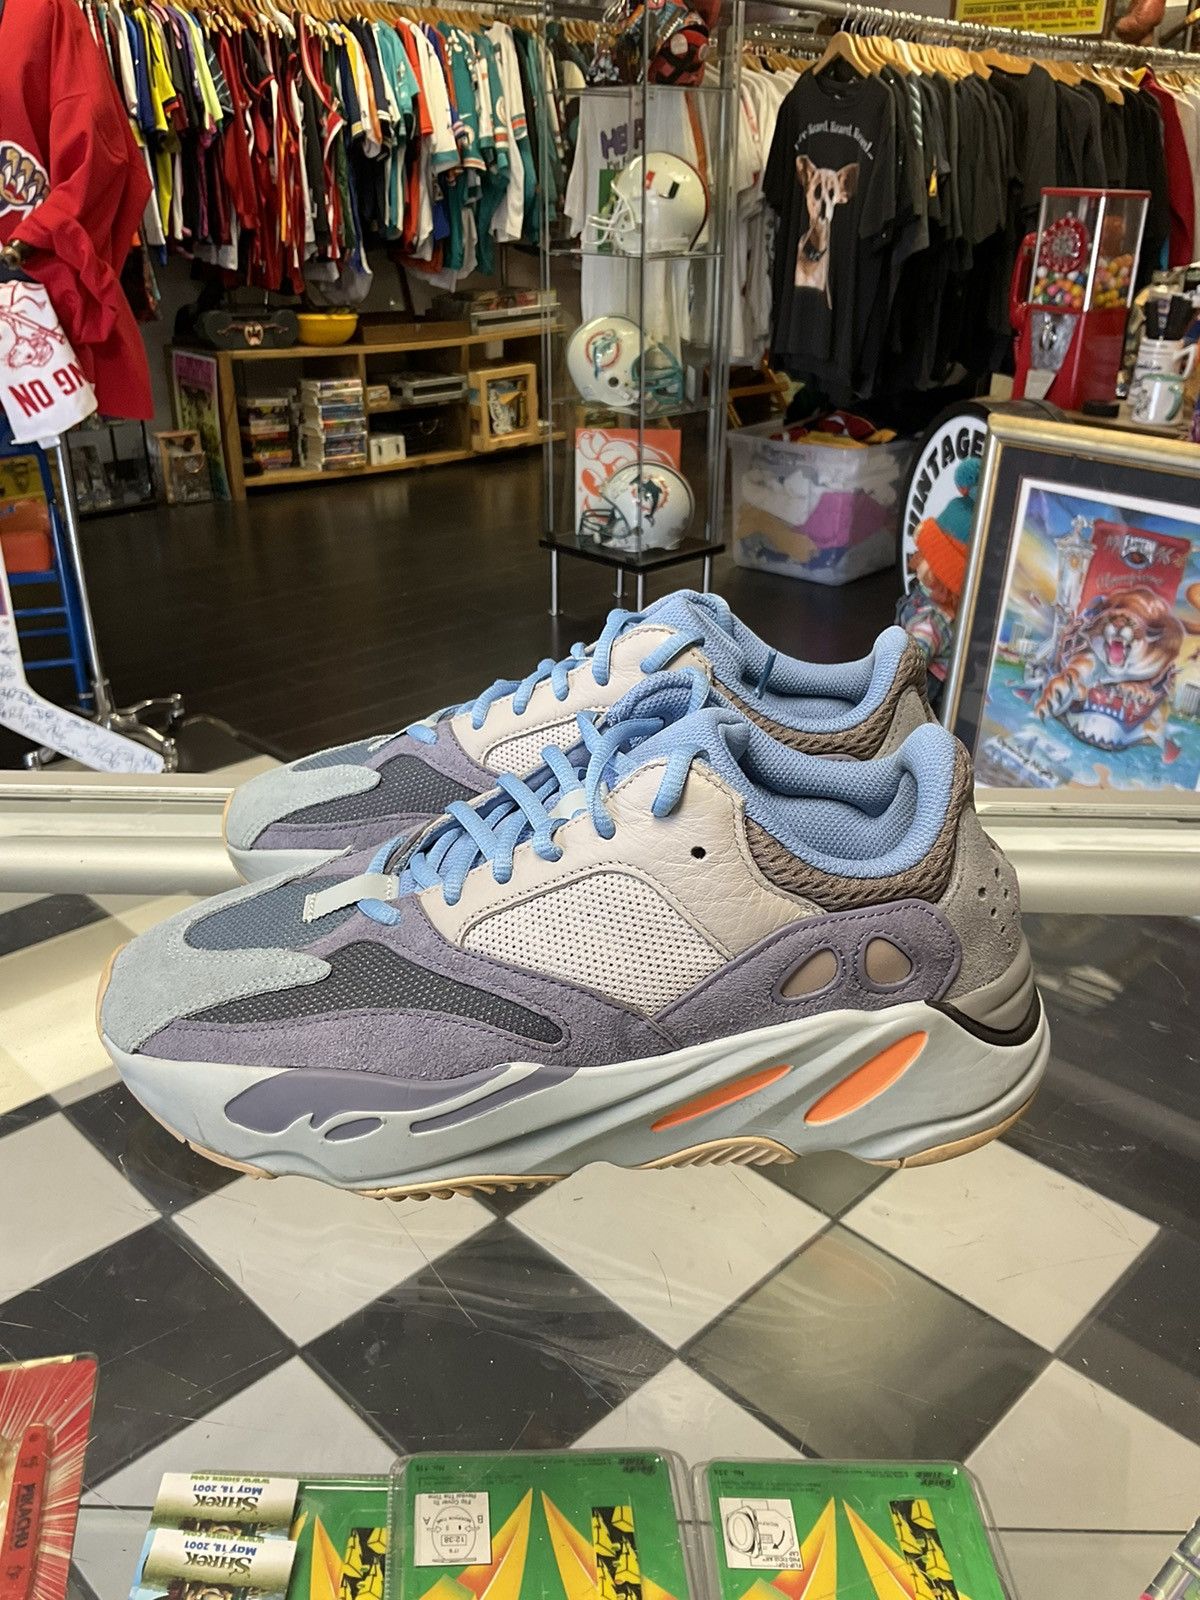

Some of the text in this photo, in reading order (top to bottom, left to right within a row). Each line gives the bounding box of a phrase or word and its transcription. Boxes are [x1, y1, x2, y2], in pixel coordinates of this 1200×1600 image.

[192, 1484, 217, 1492] 2001
[237, 1485, 263, 1495] May
[14, 1483, 36, 1549] PIKACHU
[184, 1540, 210, 1550] 2001
[230, 1545, 257, 1556] May
